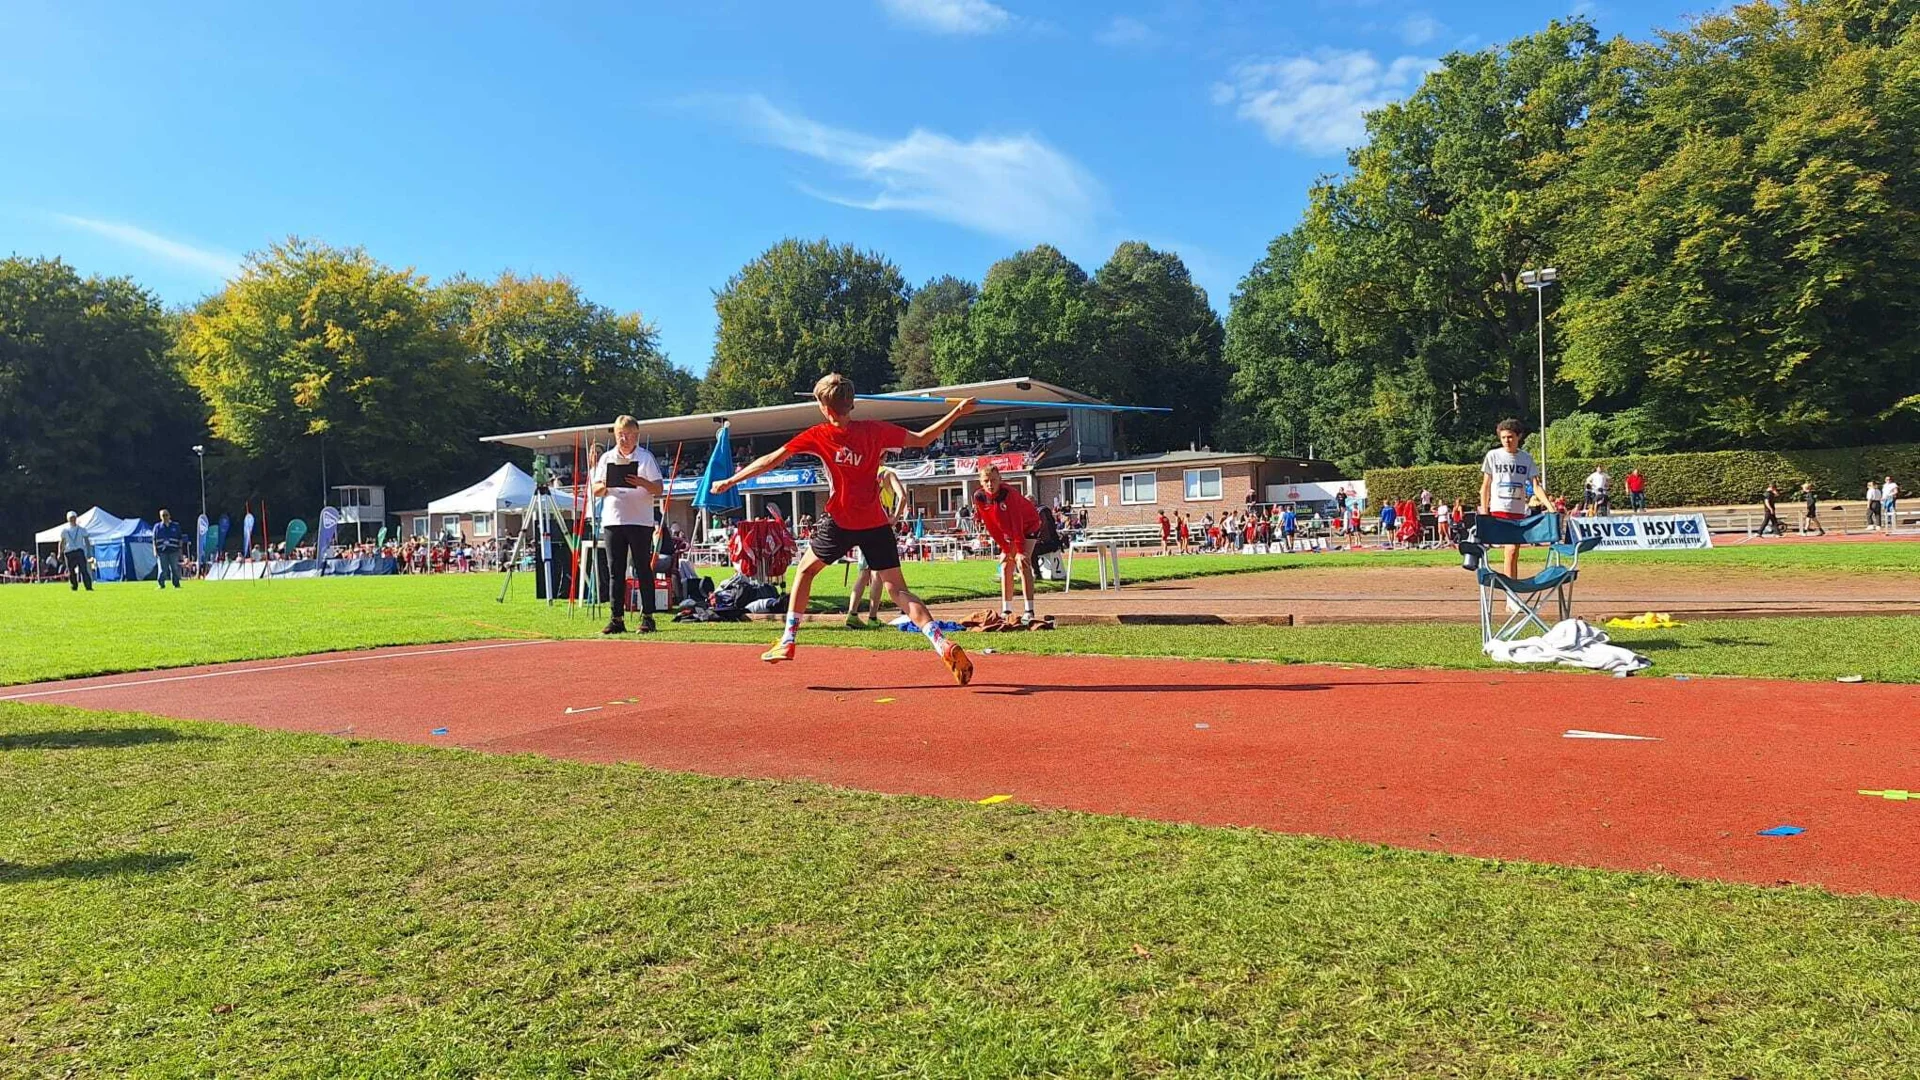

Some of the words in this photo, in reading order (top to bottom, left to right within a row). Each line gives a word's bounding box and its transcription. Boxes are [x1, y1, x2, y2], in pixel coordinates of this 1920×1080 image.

[835, 451, 862, 466] LAV
[1495, 464, 1515, 473] HSV
[1579, 523, 1611, 537] HSV
[1643, 520, 1675, 535] HSV
